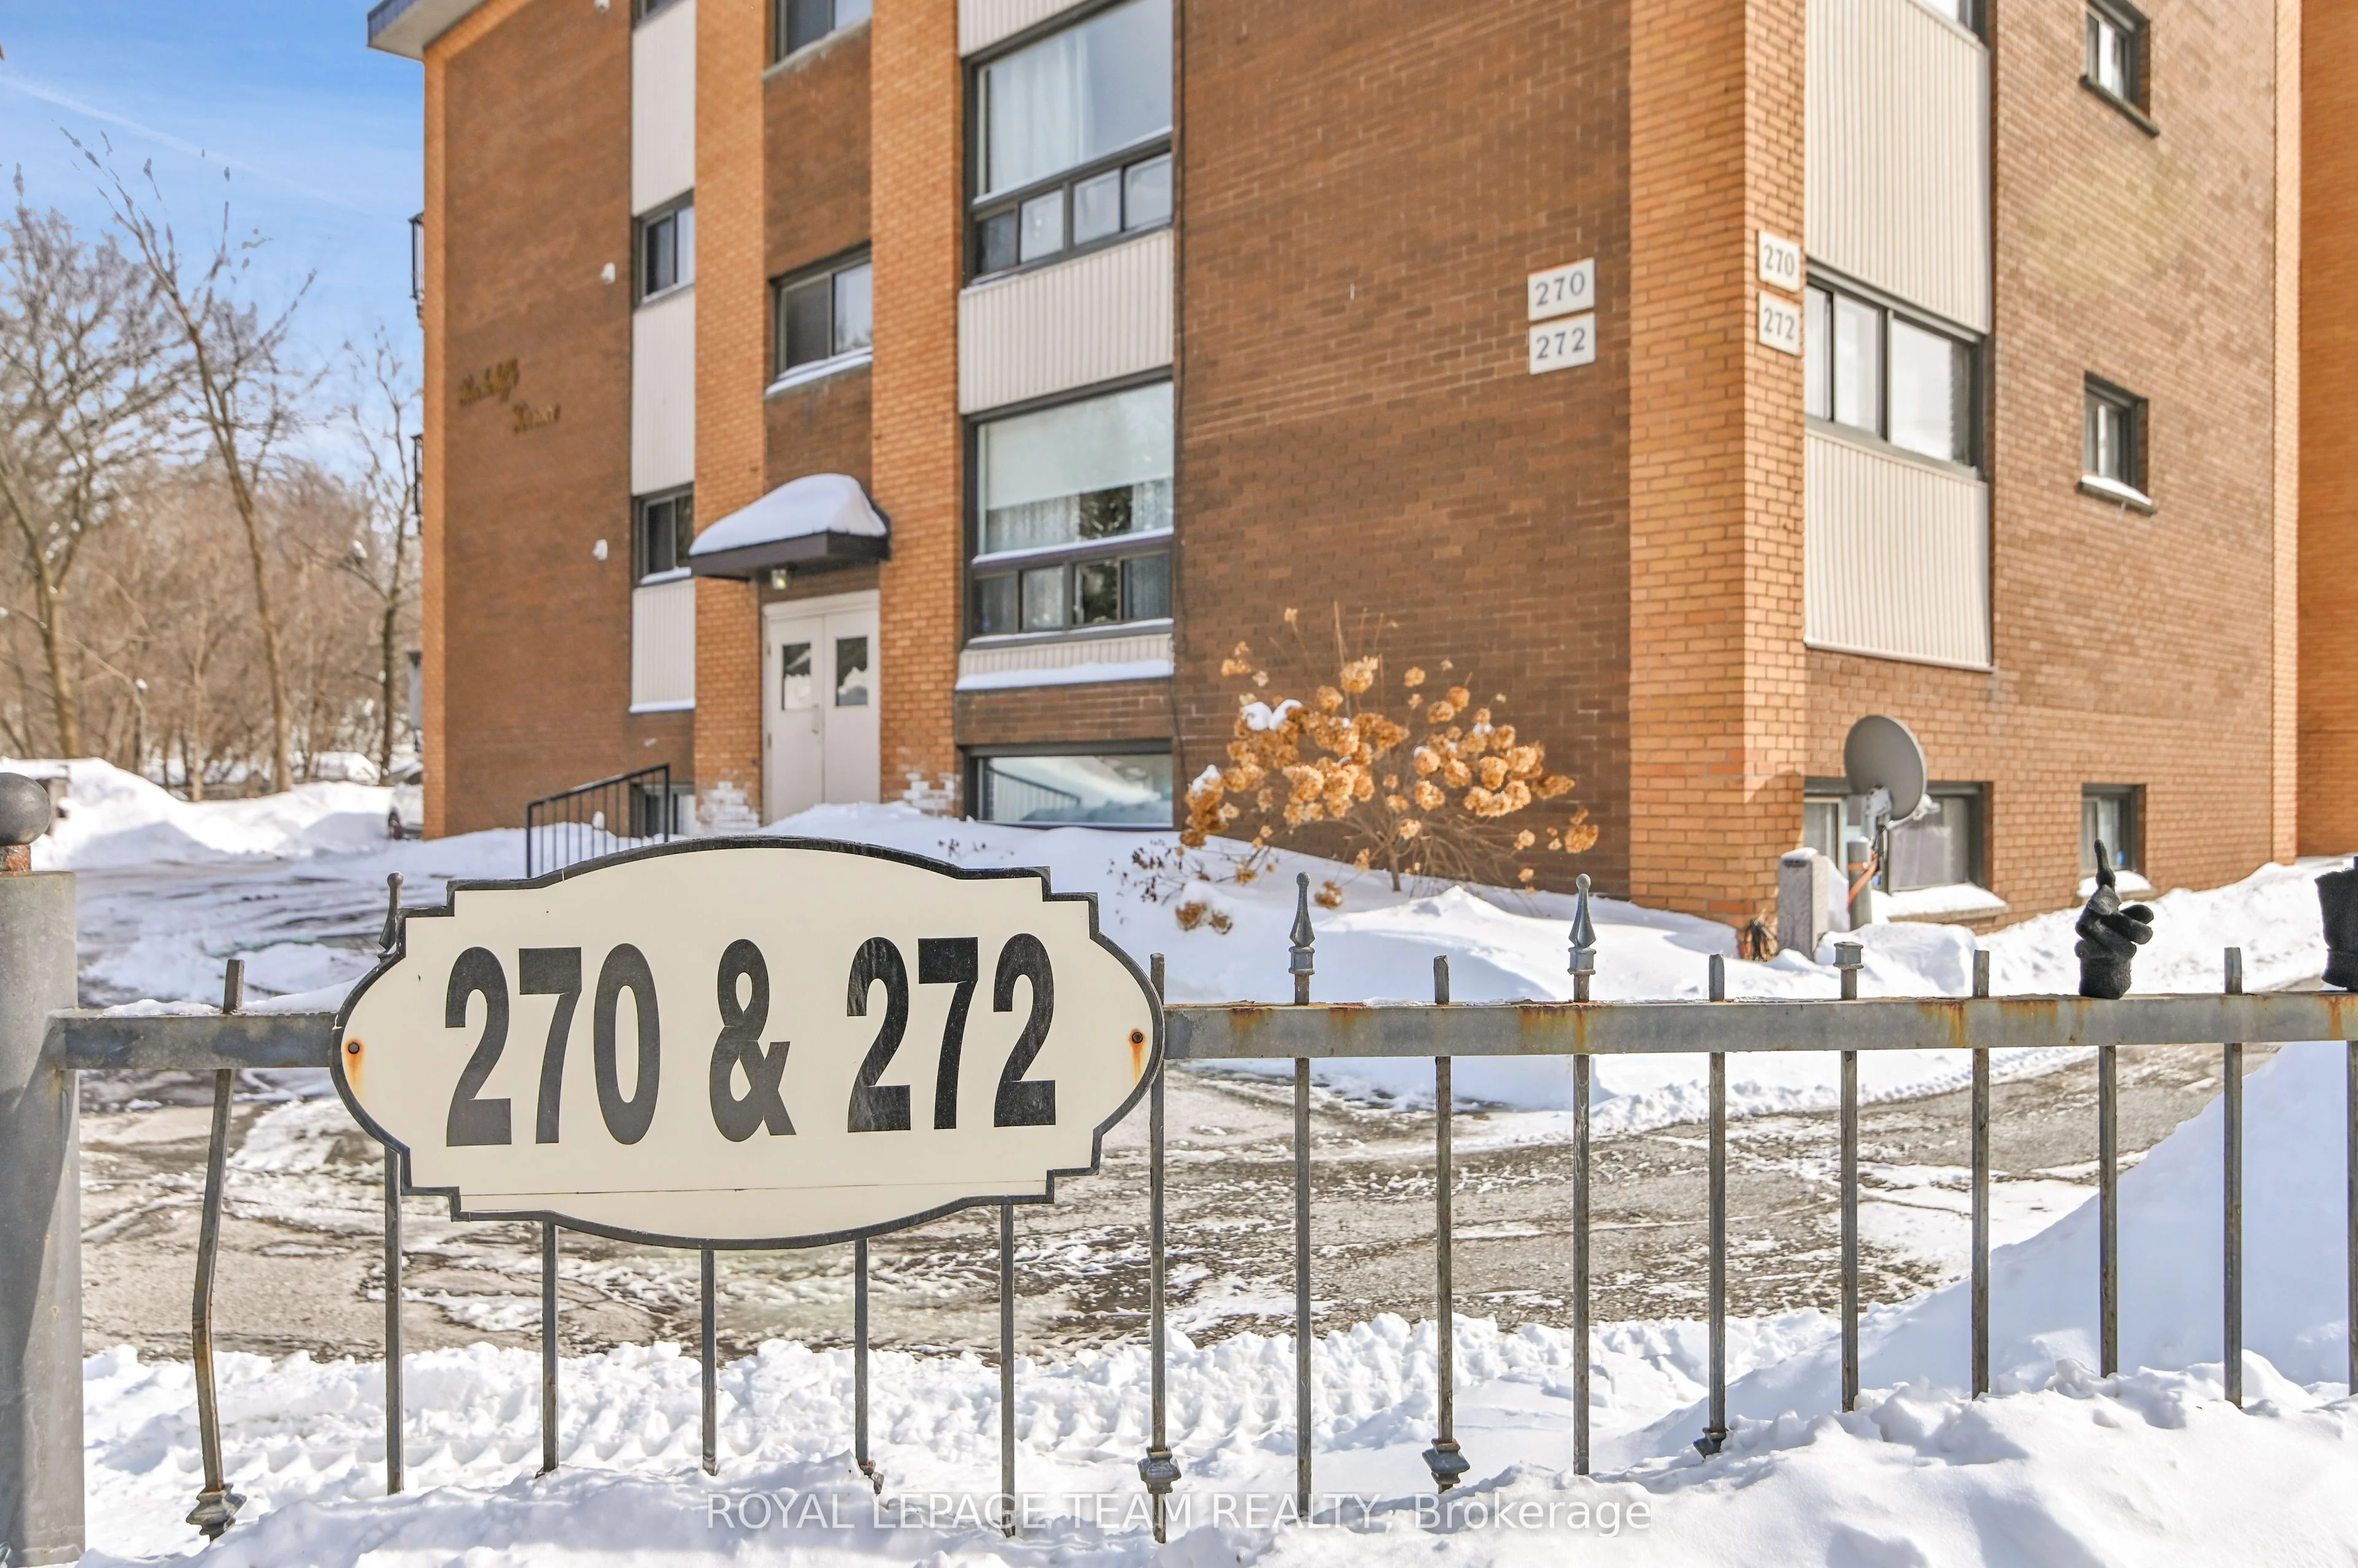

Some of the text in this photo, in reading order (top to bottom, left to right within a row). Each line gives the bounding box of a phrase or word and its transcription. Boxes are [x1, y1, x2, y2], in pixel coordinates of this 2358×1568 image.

[1764, 244, 1795, 278] 270
[1535, 271, 1586, 308] 270
[1764, 307, 1795, 341] 272
[1536, 327, 1586, 360] 272
[445, 933, 1056, 1147] 270 & 272
